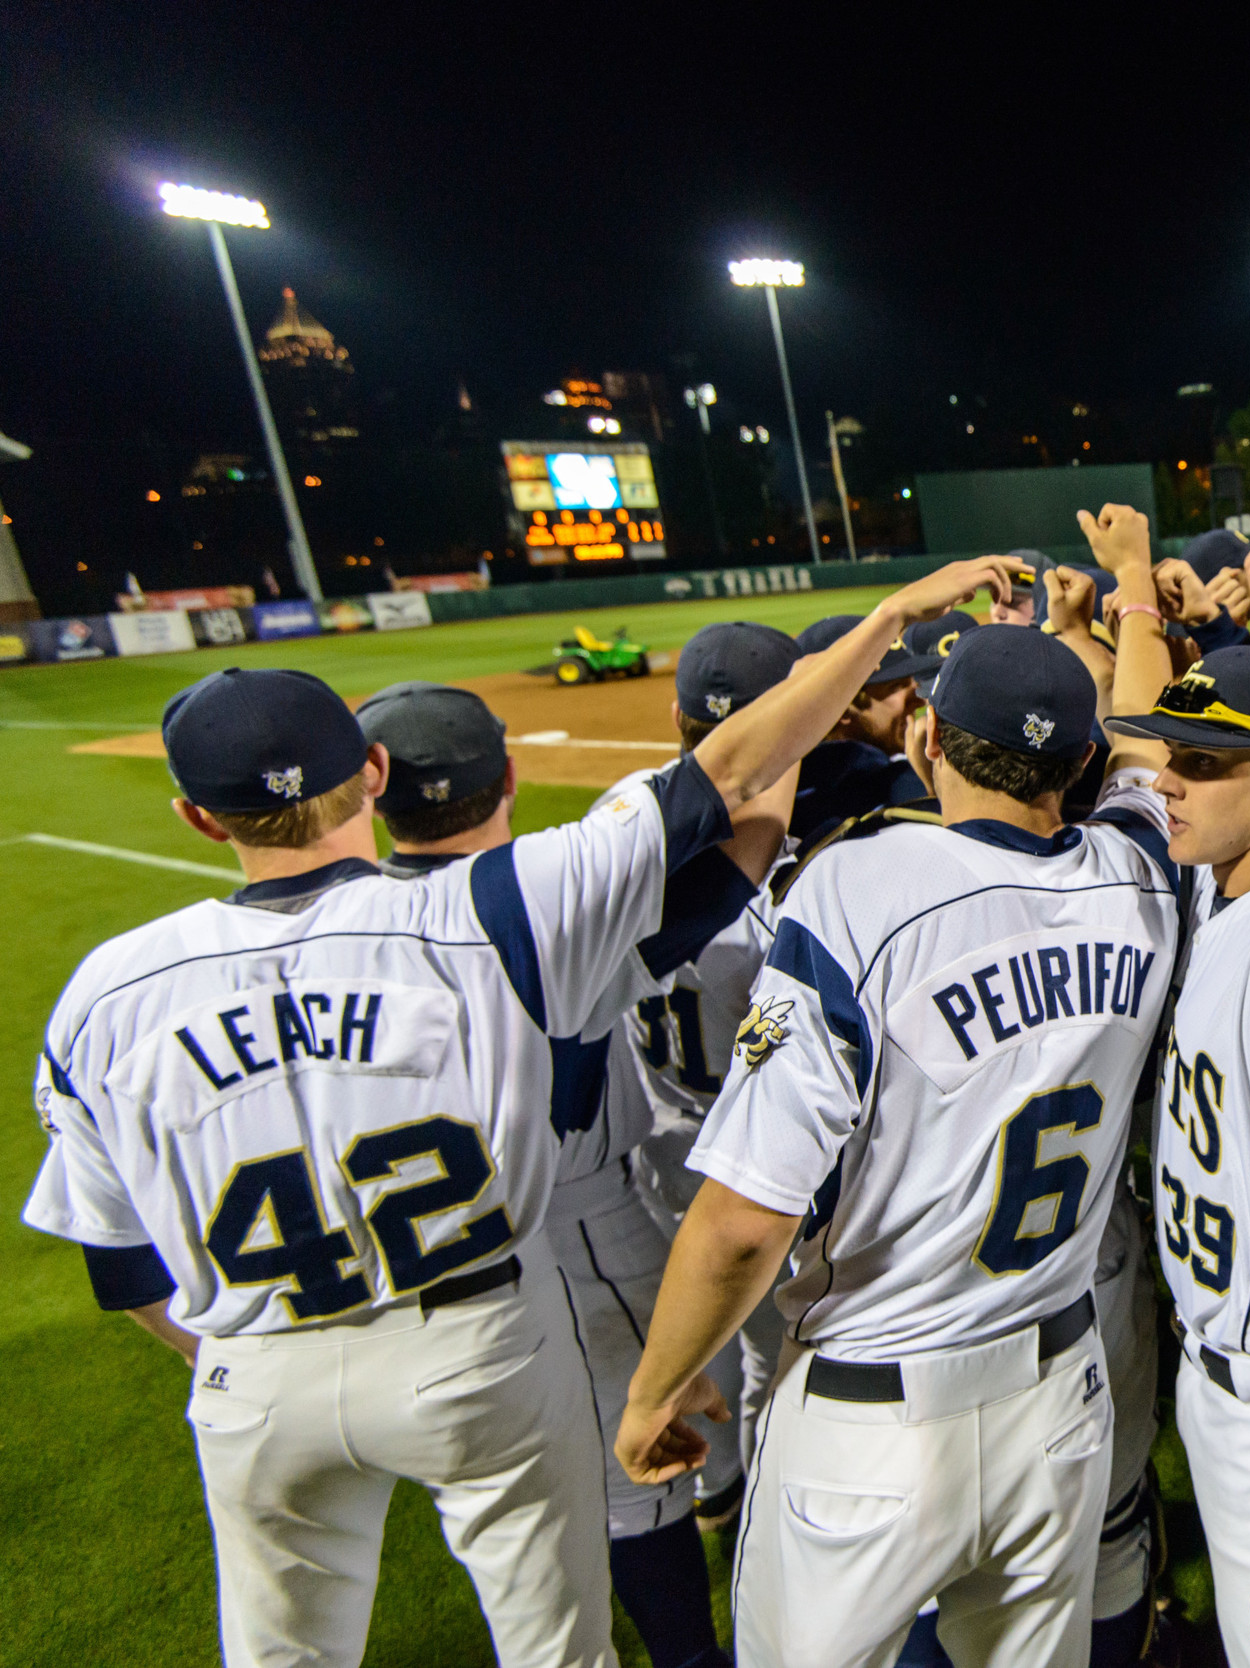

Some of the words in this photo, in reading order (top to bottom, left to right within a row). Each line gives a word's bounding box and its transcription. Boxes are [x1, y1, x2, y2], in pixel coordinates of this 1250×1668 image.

[174, 992, 383, 1091] LEACH
[932, 941, 1156, 1061] PEURIFOY
[203, 1113, 514, 1326] 42
[971, 1079, 1105, 1279] 6
[1161, 1164, 1237, 1297] 39
